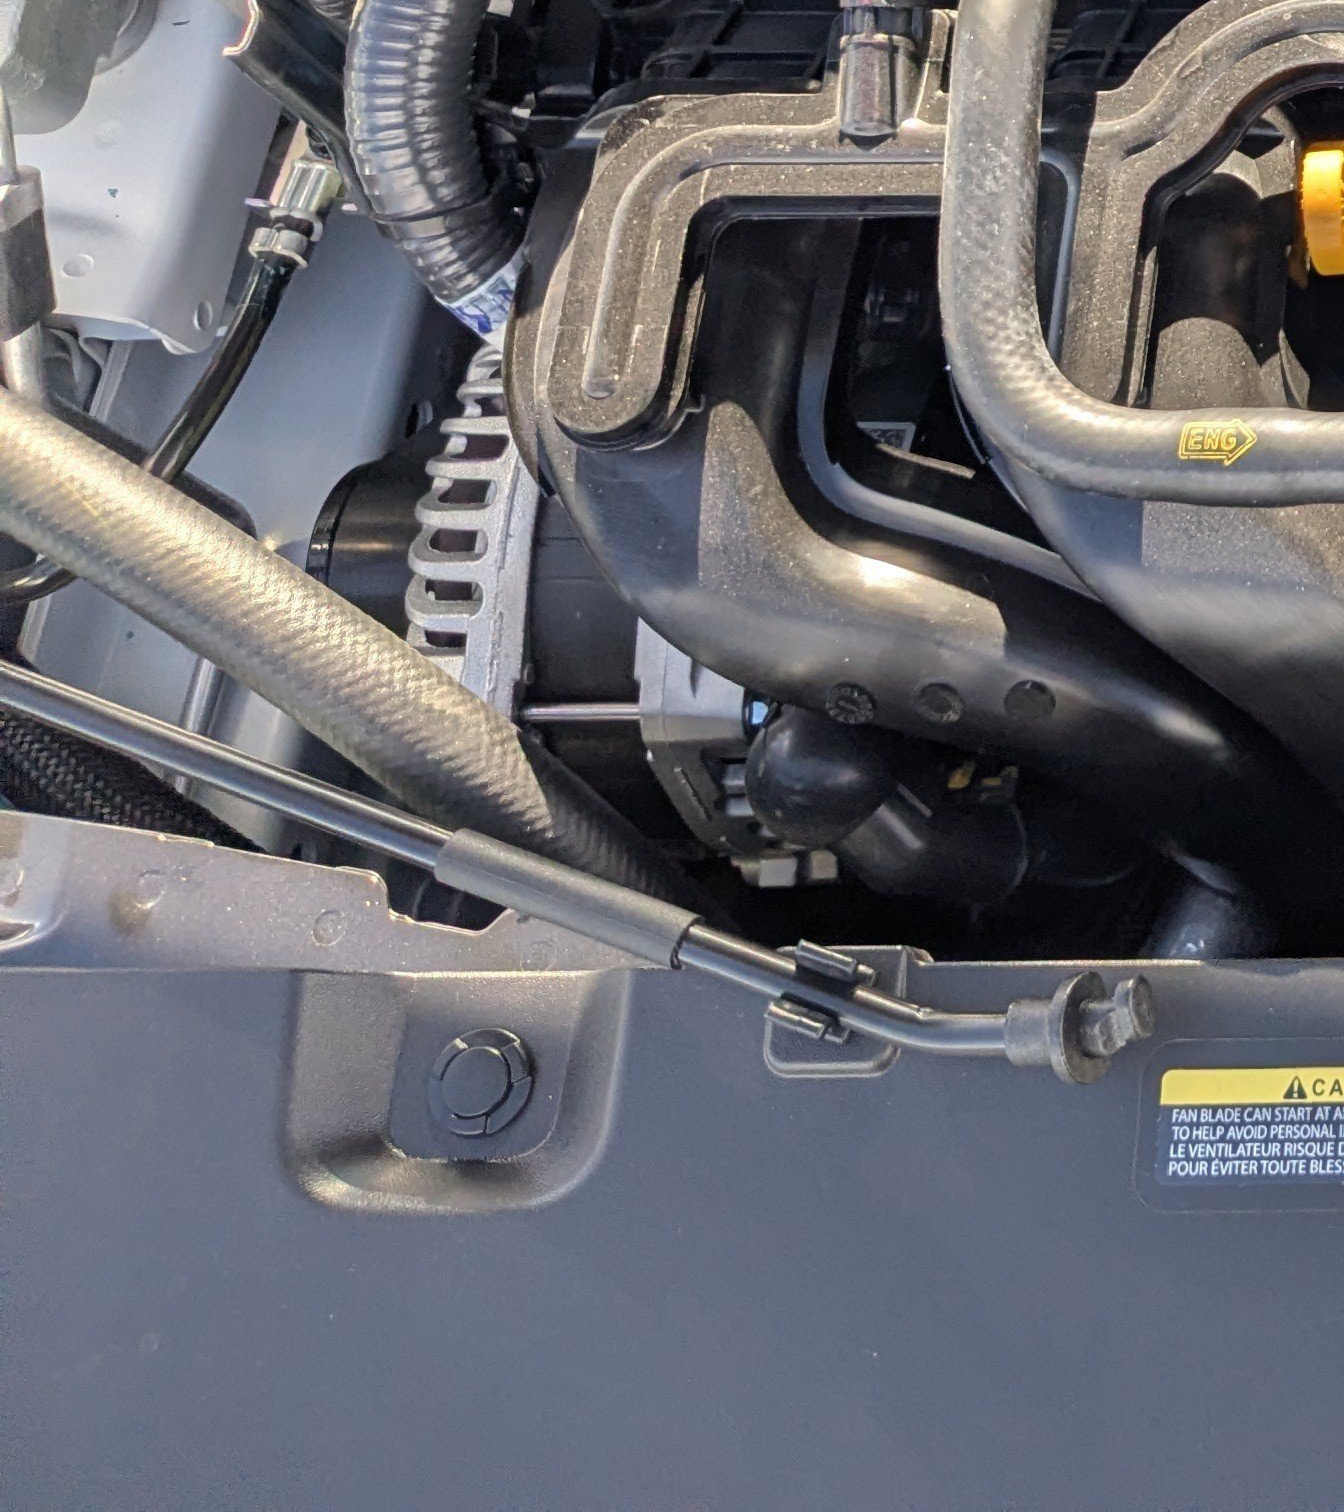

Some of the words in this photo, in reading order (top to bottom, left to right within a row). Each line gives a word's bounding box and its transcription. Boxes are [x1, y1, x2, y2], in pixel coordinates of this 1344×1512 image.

[1186, 426, 1238, 451] ENG
[1172, 1109, 1198, 1124] FAN
[1200, 1108, 1241, 1123] BLADE
[1243, 1107, 1272, 1122] CAN
[1274, 1107, 1312, 1121] START
[1314, 1106, 1331, 1121] AT
[1172, 1126, 1190, 1141] TO
[1193, 1125, 1224, 1140] HELP
[1226, 1125, 1267, 1139] AVOID
[1270, 1124, 1336, 1139] PERSONAL
[1169, 1143, 1186, 1158] LE
[1189, 1142, 1280, 1157] VENTILATEUR
[1284, 1141, 1334, 1158] RISQUE
[1168, 1160, 1208, 1176] POUR
[1211, 1156, 1258, 1176] ÉVITER
[1260, 1160, 1306, 1174] TOUTE
